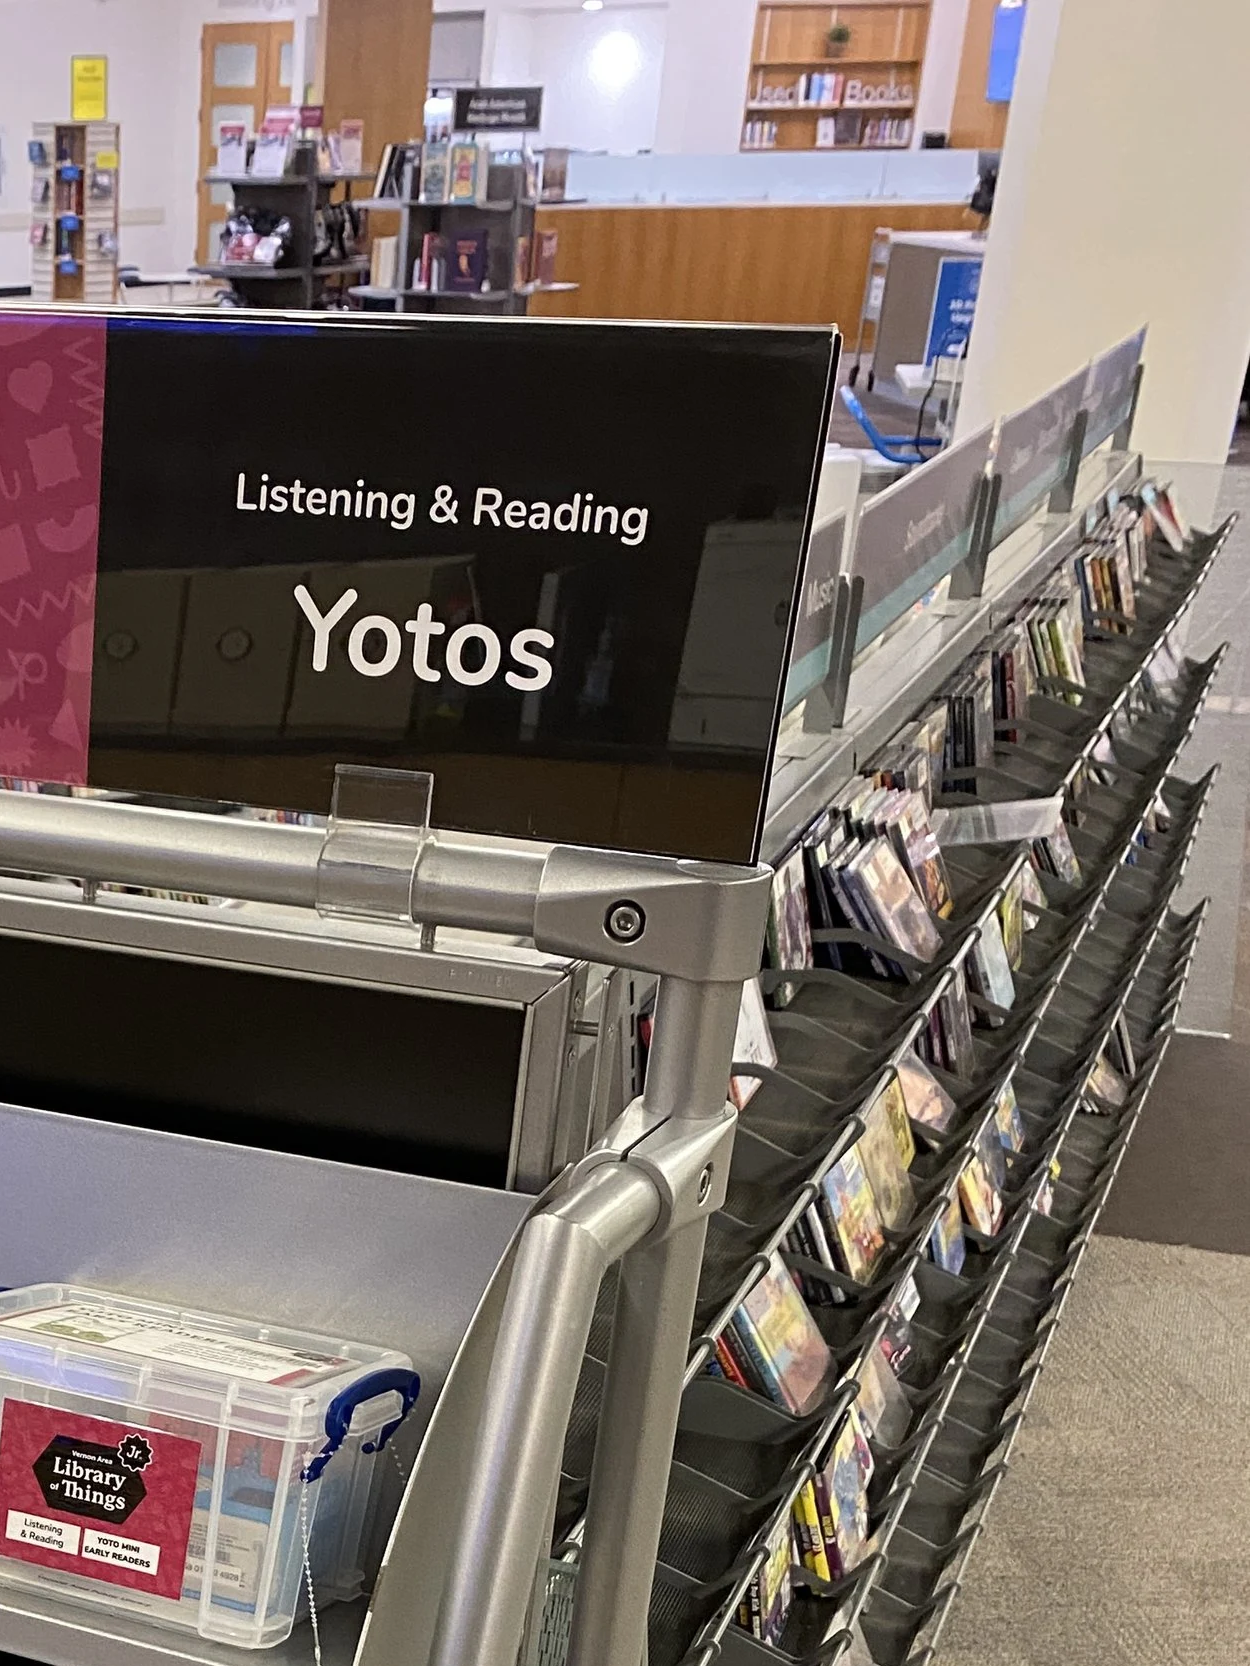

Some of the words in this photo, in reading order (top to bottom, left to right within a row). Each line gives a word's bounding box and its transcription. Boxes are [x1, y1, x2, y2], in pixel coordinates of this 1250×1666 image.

[235, 472, 417, 531] Listening
[428, 484, 459, 525] &
[473, 487, 649, 546] Reading
[293, 584, 555, 692] Yotos
[72, 1450, 96, 1461] Vernon
[97, 1456, 113, 1465] Area
[53, 1456, 127, 1491] Library
[50, 1483, 60, 1491] of
[61, 1479, 126, 1511] Things
[20, 1529, 27, 1539] &
[29, 1531, 64, 1549] Reading
[24, 1518, 63, 1536] Listening
[84, 1545, 111, 1559] EARLY
[111, 1552, 151, 1569] READERS
[97, 1536, 120, 1549] YOTO
[121, 1542, 140, 1554] MINI
